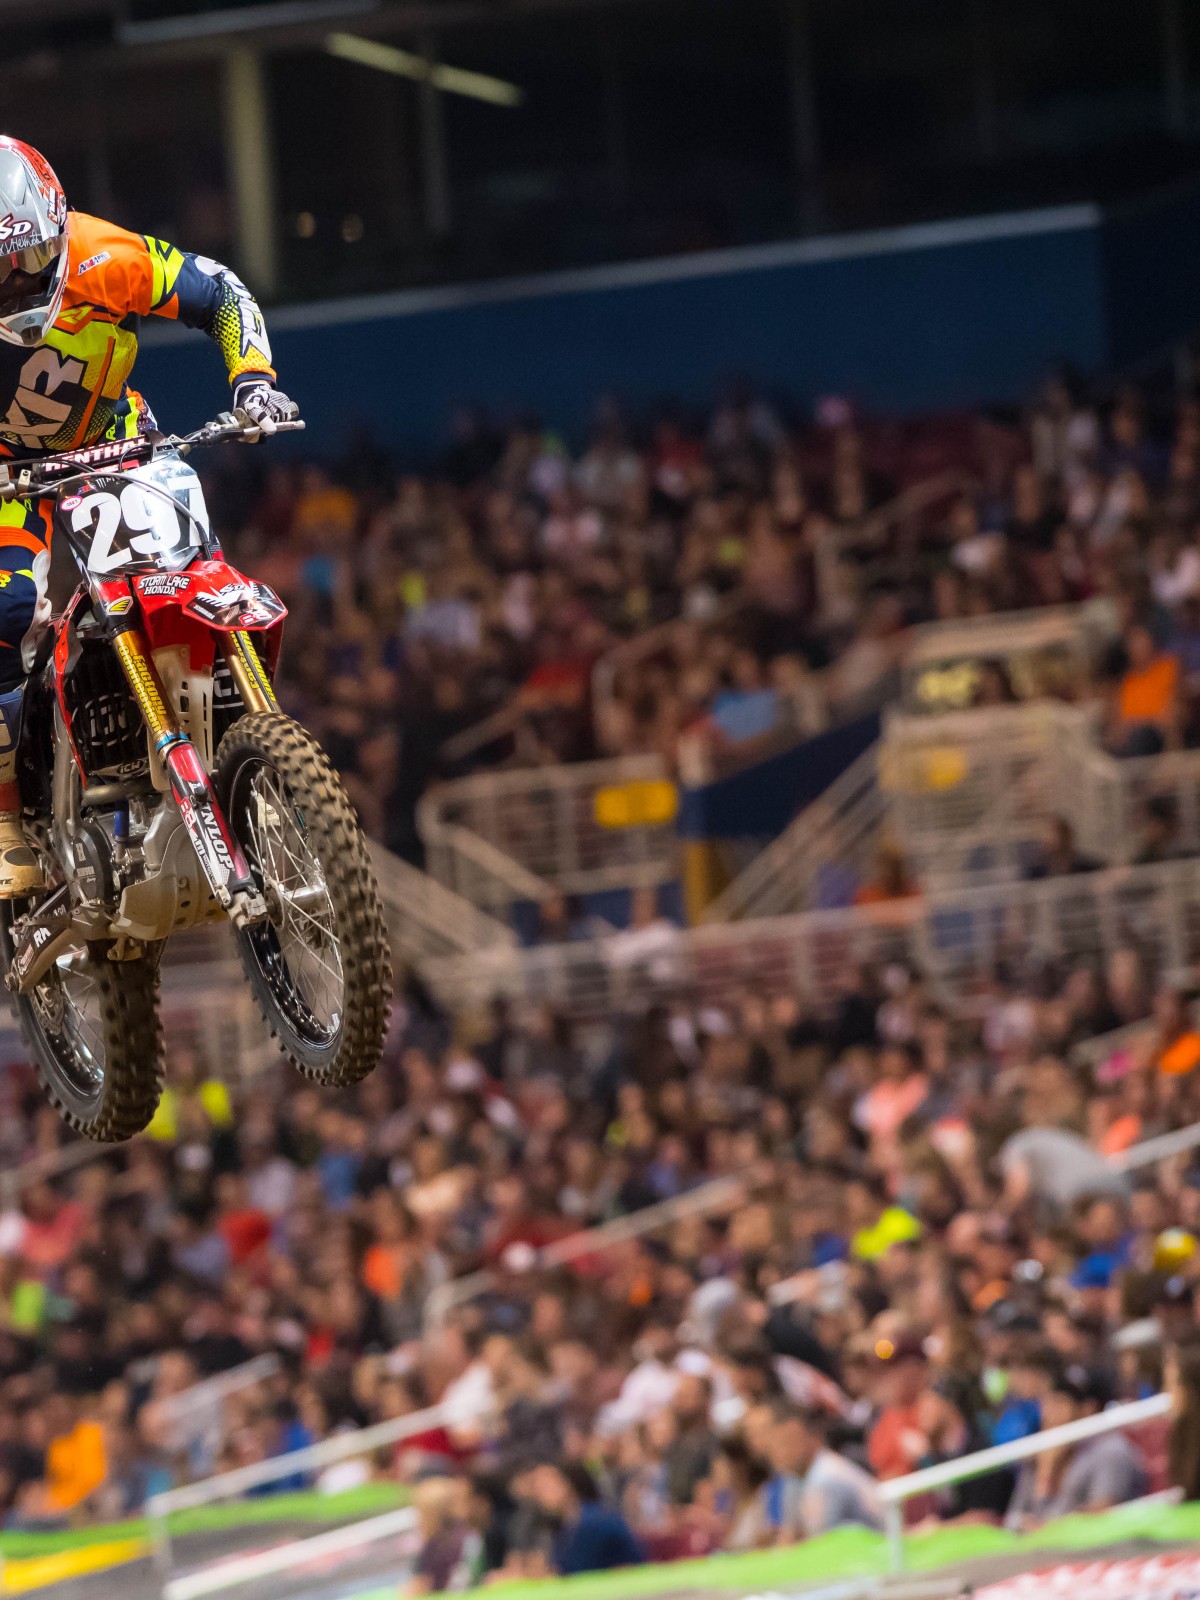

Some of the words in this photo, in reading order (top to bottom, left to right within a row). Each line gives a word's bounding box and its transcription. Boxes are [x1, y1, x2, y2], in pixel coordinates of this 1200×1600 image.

[71, 474, 211, 573] 297
[138, 575, 167, 589] STORM
[166, 574, 190, 590] LAKE
[144, 585, 176, 596] HONDA
